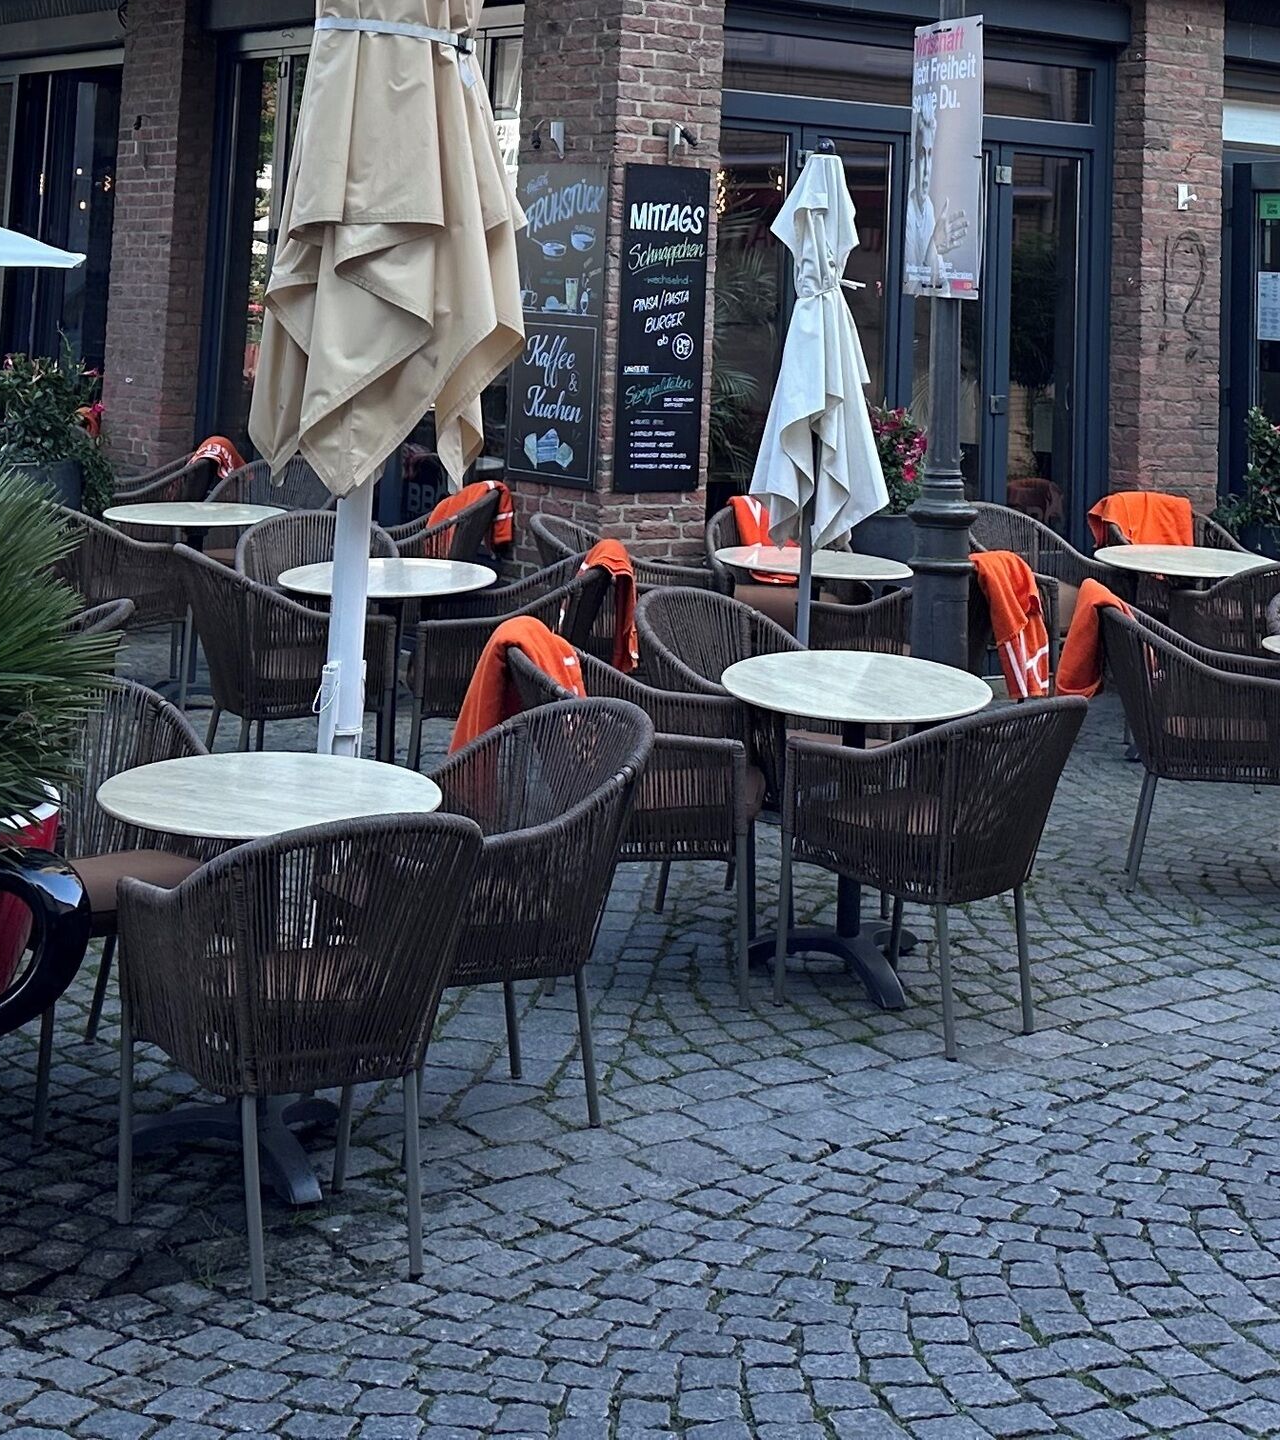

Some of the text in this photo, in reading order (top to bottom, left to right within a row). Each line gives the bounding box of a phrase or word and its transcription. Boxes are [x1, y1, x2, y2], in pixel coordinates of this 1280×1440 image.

[931, 52, 977, 82] Freiheit
[940, 84, 961, 110] Du.
[524, 178, 605, 238] FRÜHSTÜCK
[629, 202, 705, 235] MITTAGS
[628, 236, 705, 271] Schnäppchen
[644, 311, 685, 333] BURGER
[656, 334, 669, 346] ab
[522, 334, 576, 389] Kaffee
[523, 385, 583, 424] Kuchen
